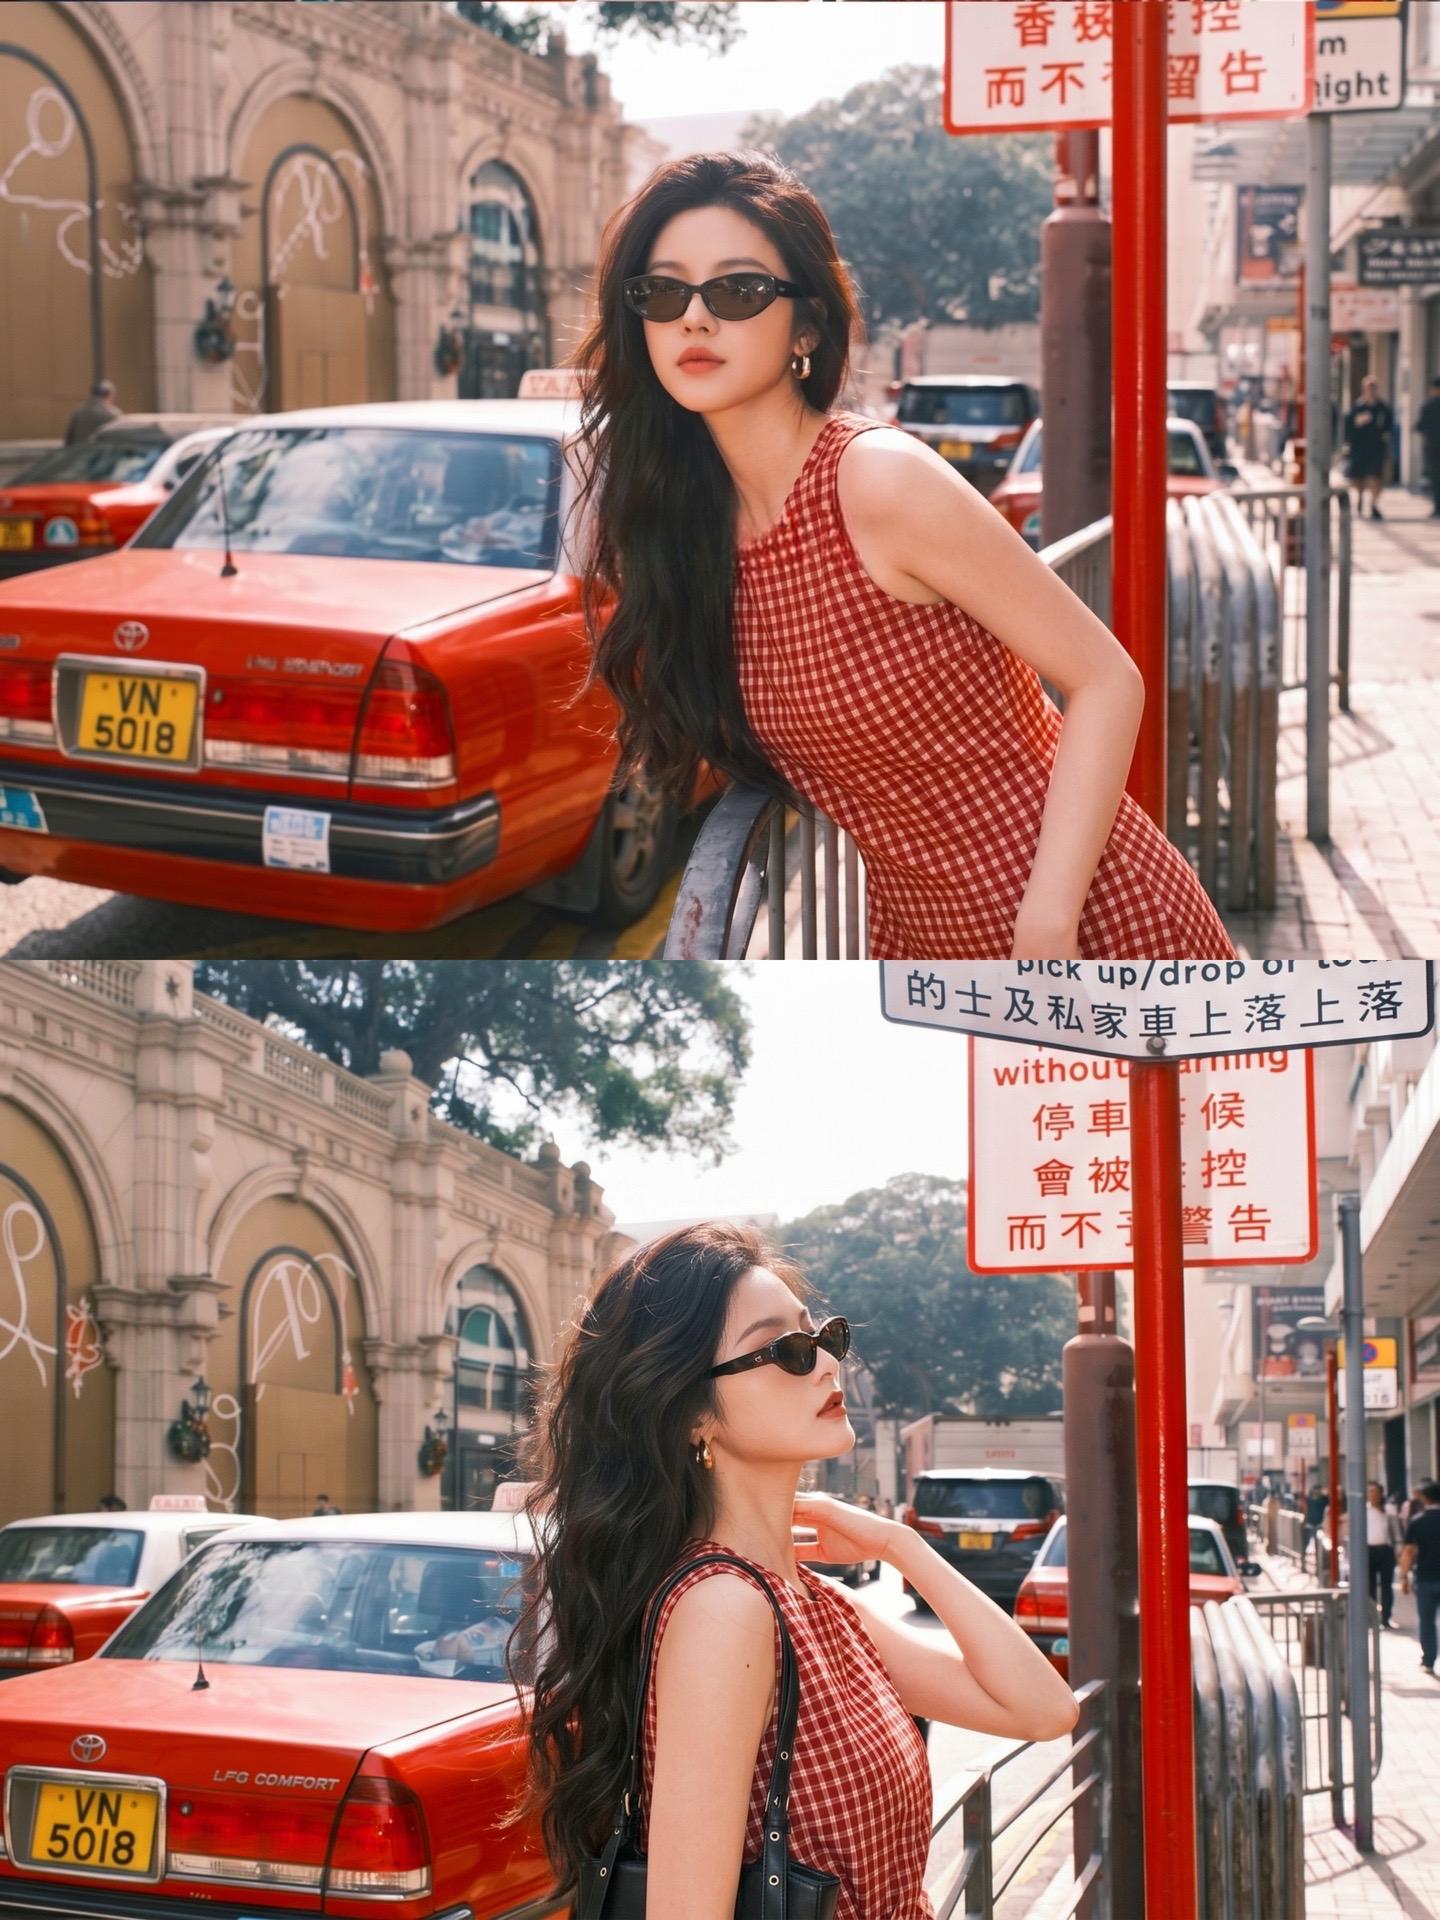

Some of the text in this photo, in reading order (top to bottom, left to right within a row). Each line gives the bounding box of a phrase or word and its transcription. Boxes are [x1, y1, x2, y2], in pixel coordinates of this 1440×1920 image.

[1319, 36, 1347, 54] m
[117, 679, 162, 716] VN
[93, 714, 175, 755] 5018
[906, 969, 1404, 1039] 的士及私家車上落上落
[993, 1050, 1289, 1087] without arning
[1033, 1091, 1246, 1142] 停車候
[1033, 1148, 1248, 1198] 會被控
[254, 1772, 341, 1791] COMFORT
[75, 1789, 122, 1827] VN
[47, 1823, 135, 1865] 5018
